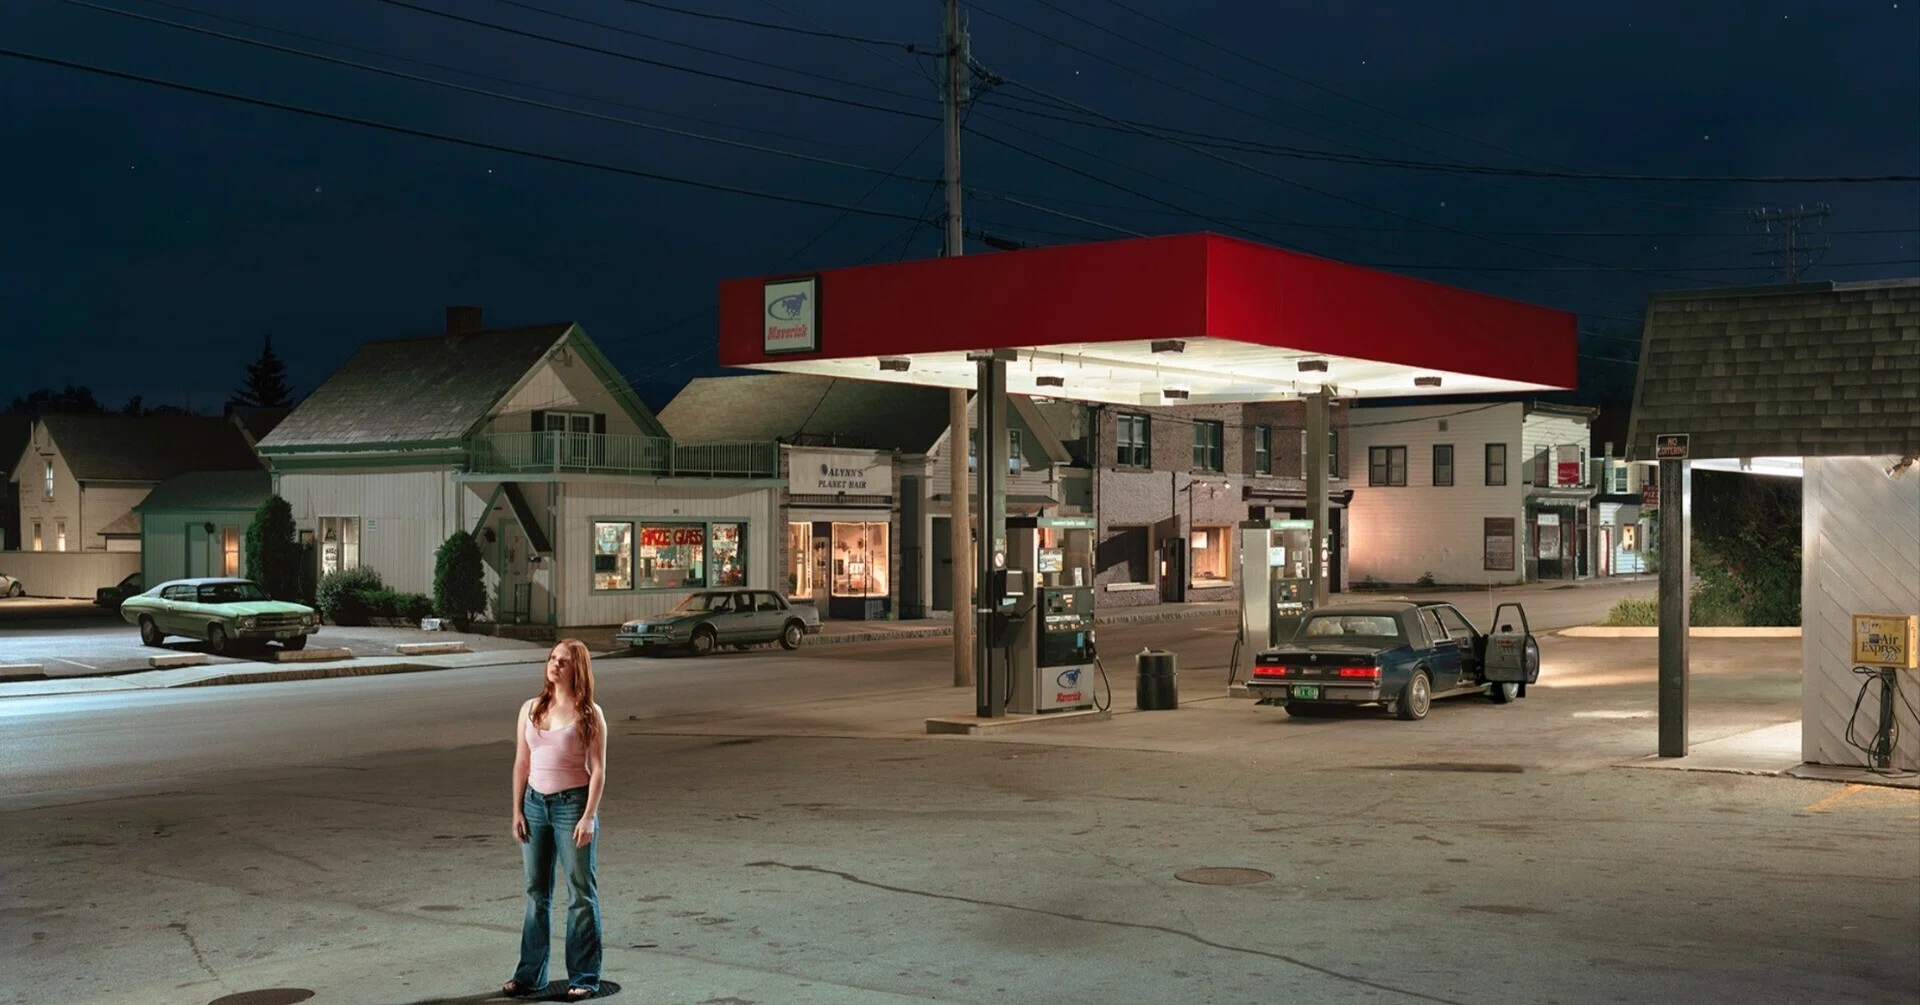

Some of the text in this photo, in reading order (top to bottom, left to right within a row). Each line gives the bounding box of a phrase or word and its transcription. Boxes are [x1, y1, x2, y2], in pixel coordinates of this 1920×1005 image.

[1667, 437, 1678, 446] NO
[827, 468, 864, 478] ALYNN'S
[818, 480, 867, 489] PLANET HAIR
[673, 529, 703, 545] GLASS
[1881, 634, 1899, 645] Air
[1862, 640, 1902, 656] Express
